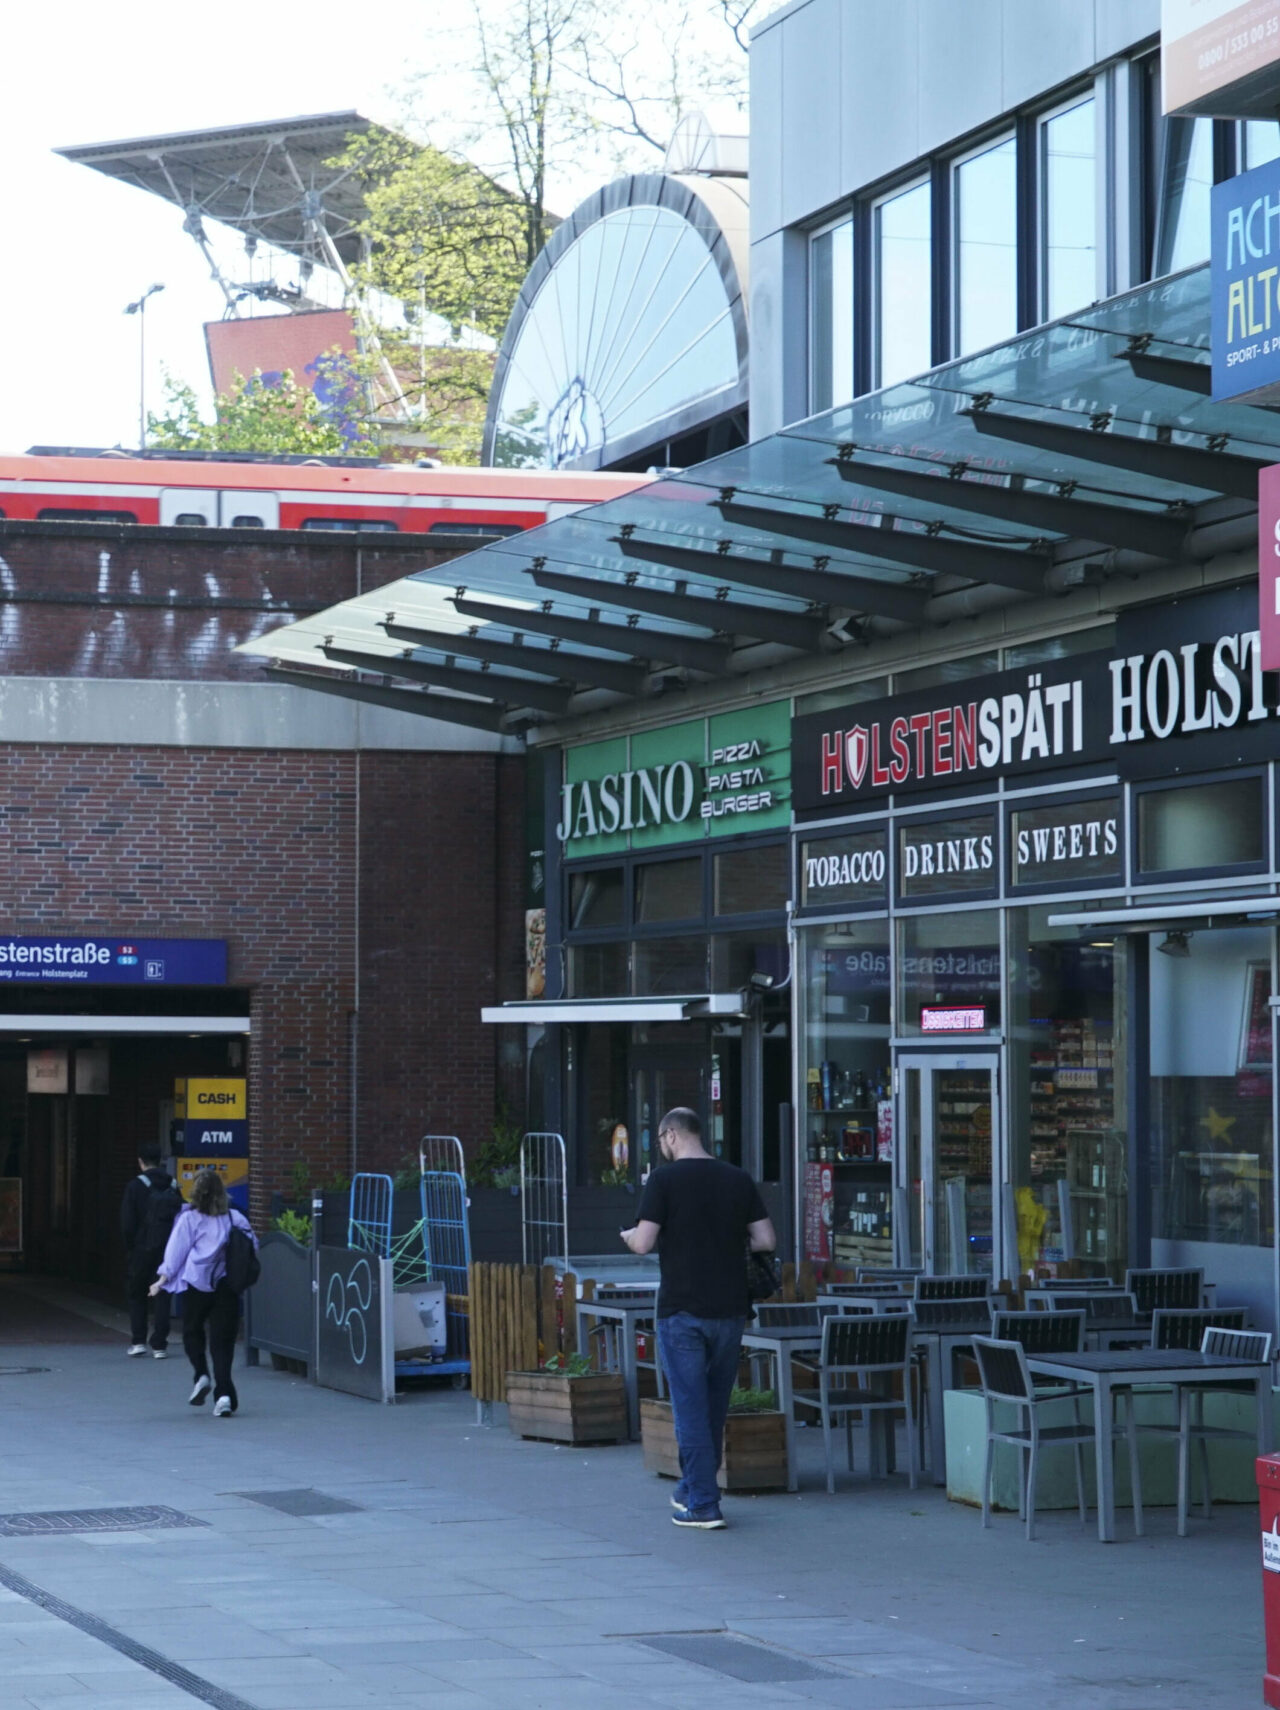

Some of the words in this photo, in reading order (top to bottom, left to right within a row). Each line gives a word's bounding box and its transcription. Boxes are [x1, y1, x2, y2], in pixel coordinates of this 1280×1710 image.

[1250, 24, 1265, 43] 00
[1266, 16, 1279, 36] 55
[1226, 266, 1280, 344] ALT
[1109, 630, 1280, 745] HOLST
[712, 740, 761, 765] PIZZA
[709, 767, 764, 792] PASTA
[556, 760, 694, 841] JASINO
[700, 791, 772, 818] BURGER
[1018, 818, 1117, 865] SWEETS
[806, 849, 886, 889] TOBACCO
[905, 835, 993, 878] DRINKS
[42, 969, 88, 979] Holstenplatz
[197, 1092, 236, 1104] CASH
[201, 1131, 233, 1143] ATM
